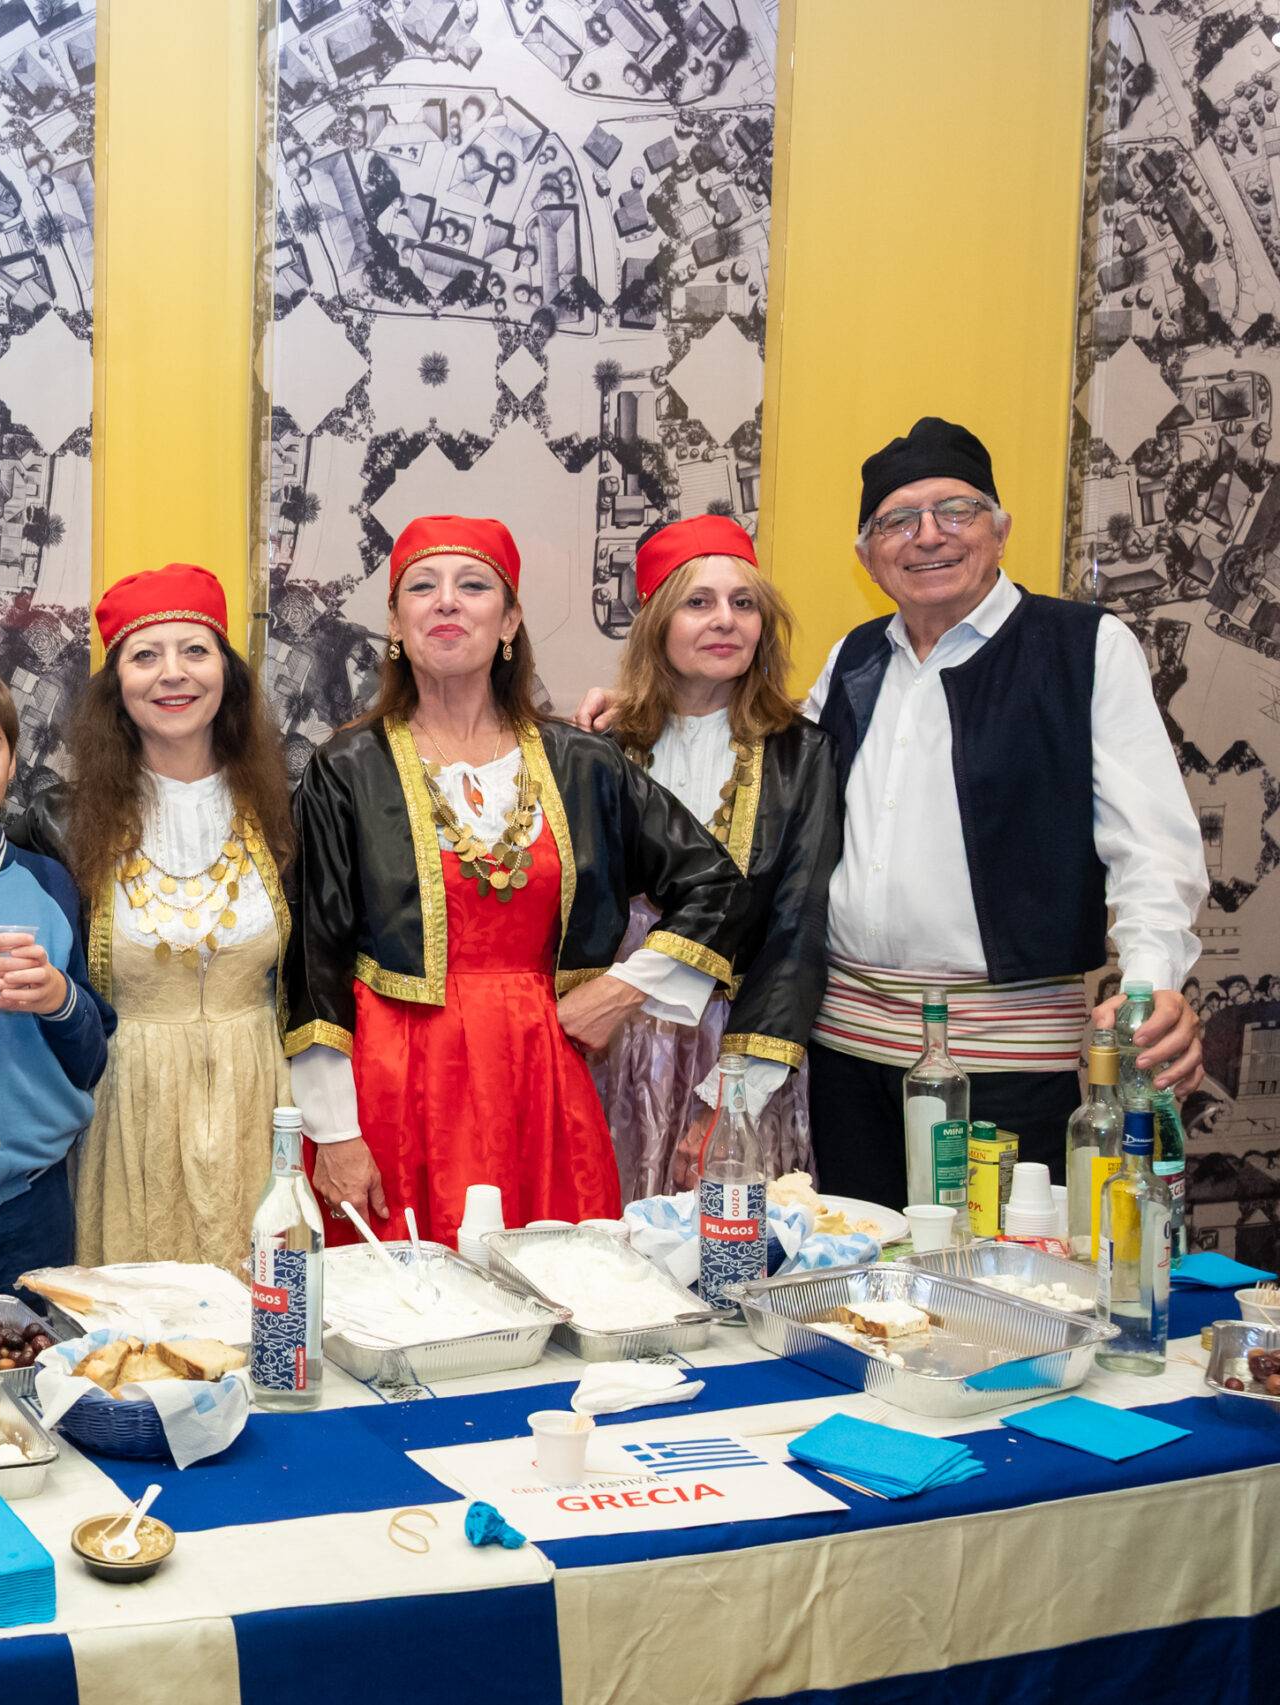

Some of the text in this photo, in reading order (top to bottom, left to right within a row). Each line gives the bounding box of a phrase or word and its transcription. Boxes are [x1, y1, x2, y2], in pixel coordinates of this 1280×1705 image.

[732, 1189, 740, 1217] OUZO
[706, 1222, 754, 1235] PELAGOS
[556, 1483, 726, 1512] GRECIA
